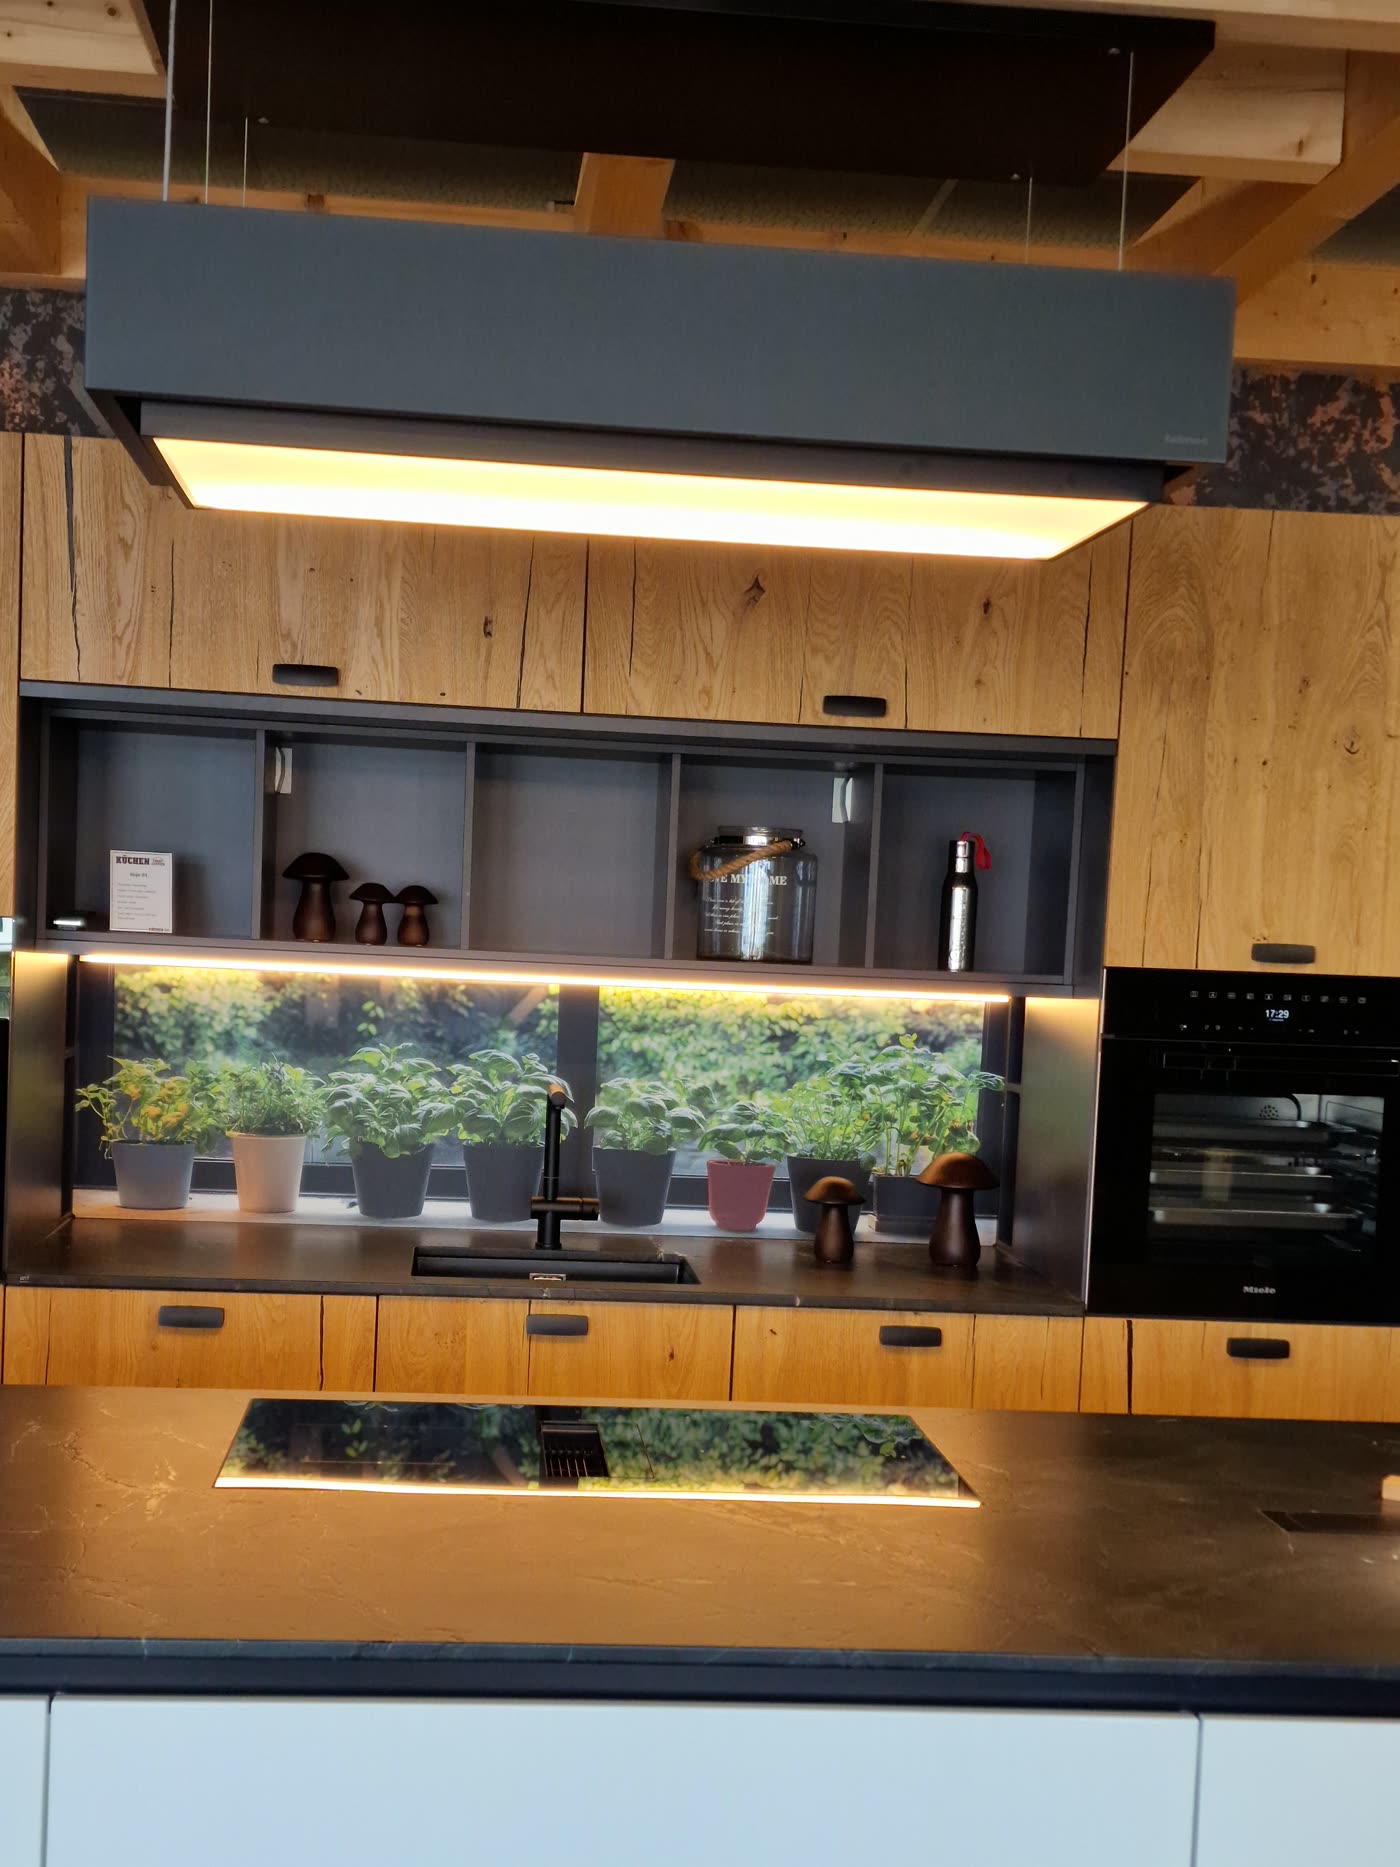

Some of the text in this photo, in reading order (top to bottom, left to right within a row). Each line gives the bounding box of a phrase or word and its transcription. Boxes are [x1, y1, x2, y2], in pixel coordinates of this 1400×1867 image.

[116, 855, 150, 866] KÜCHEN
[1265, 1009, 1290, 1019] 17:29
[1243, 1286, 1276, 1294] Miele
